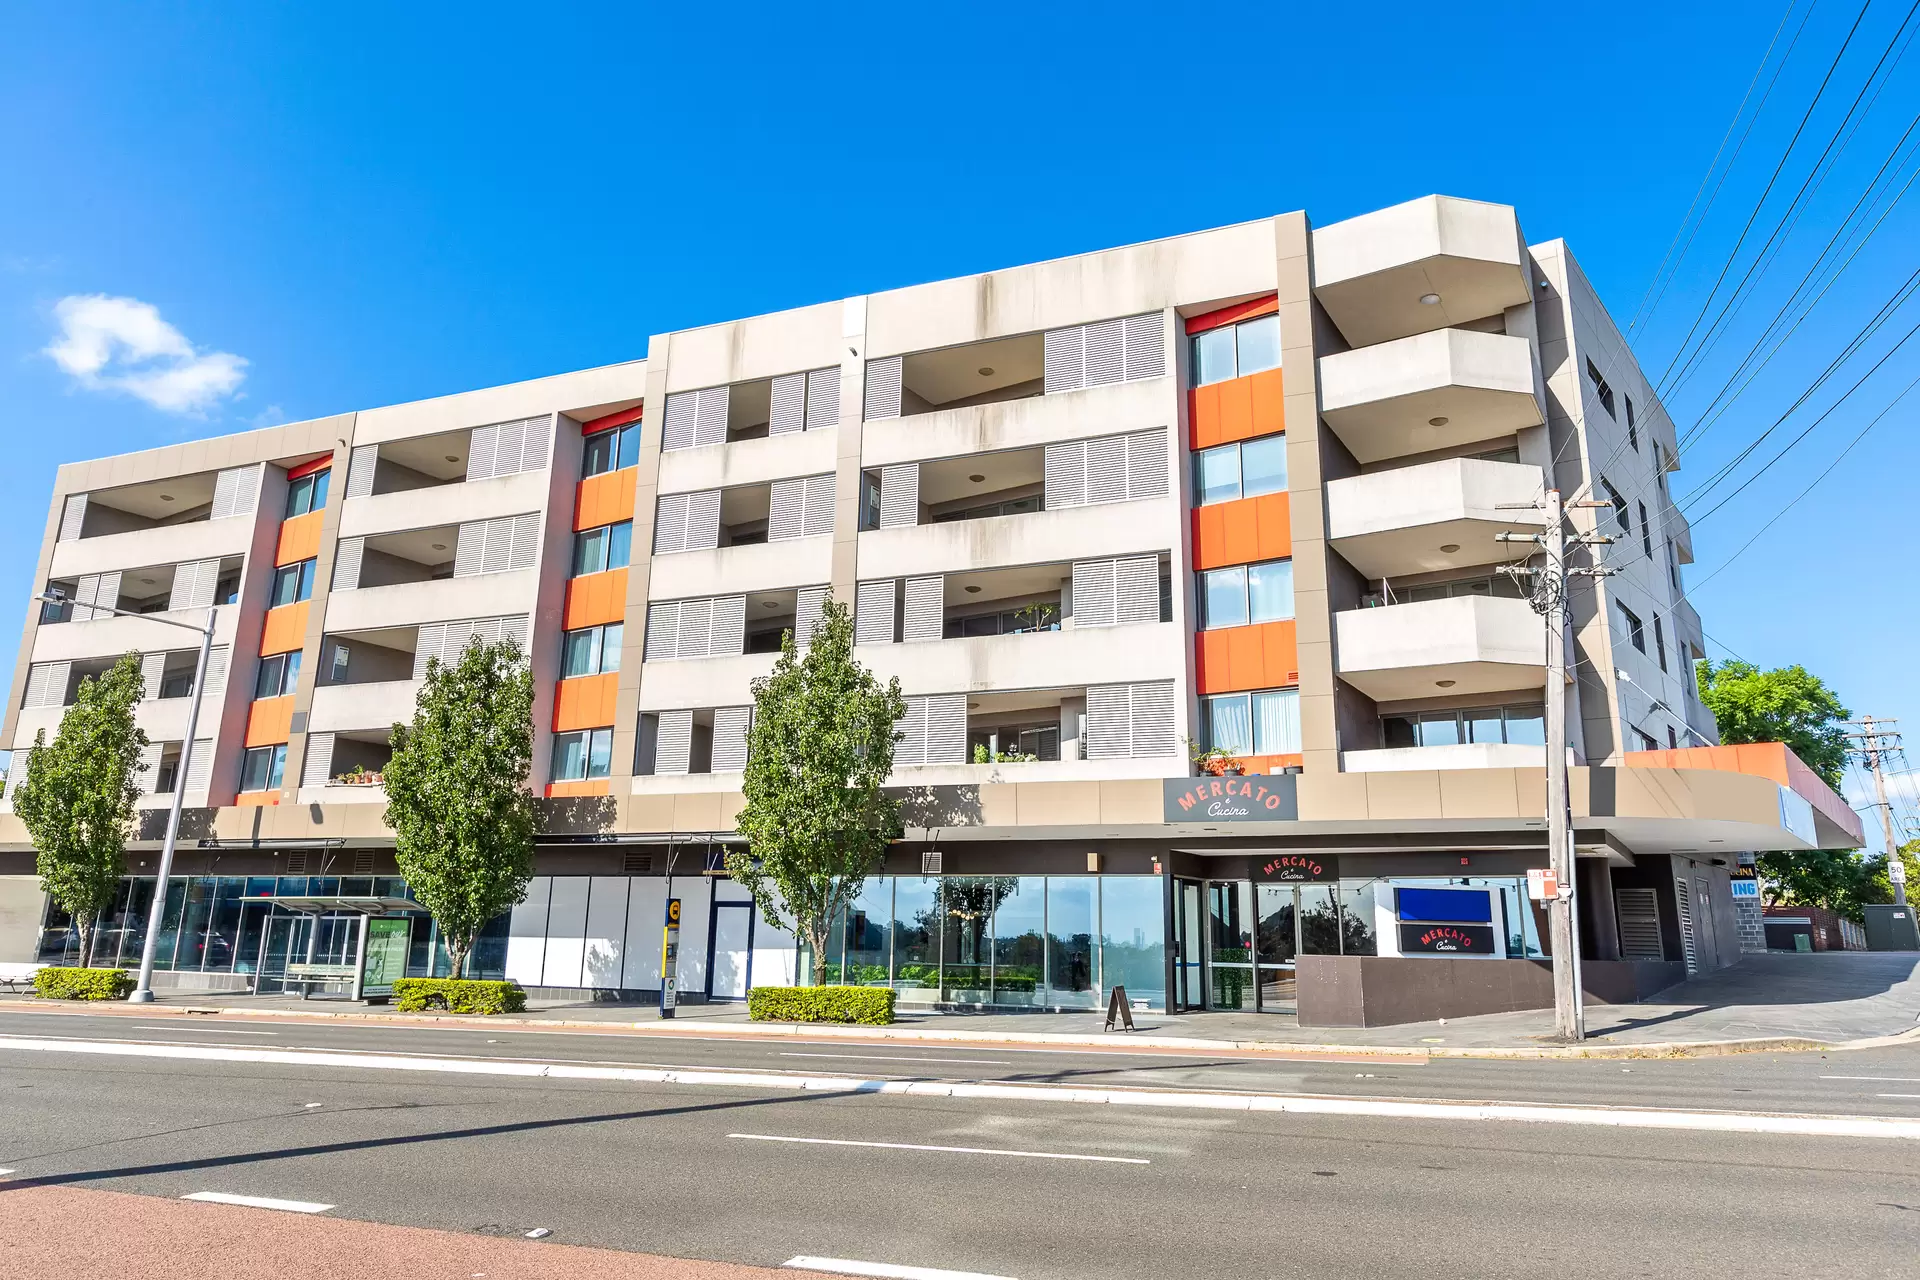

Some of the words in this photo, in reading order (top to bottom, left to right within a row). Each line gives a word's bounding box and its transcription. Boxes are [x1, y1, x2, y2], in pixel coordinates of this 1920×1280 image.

[1177, 779, 1281, 811] MERCATO
[1207, 801, 1250, 817] Cucina
[1263, 856, 1322, 876] MERCATO
[1891, 866, 1902, 874] 50
[1280, 870, 1305, 880] Cucina
[1732, 883, 1756, 896] ING
[369, 930, 390, 938] SAVE
[1420, 928, 1472, 947] MERCATO
[1435, 941, 1457, 951] Cucina
